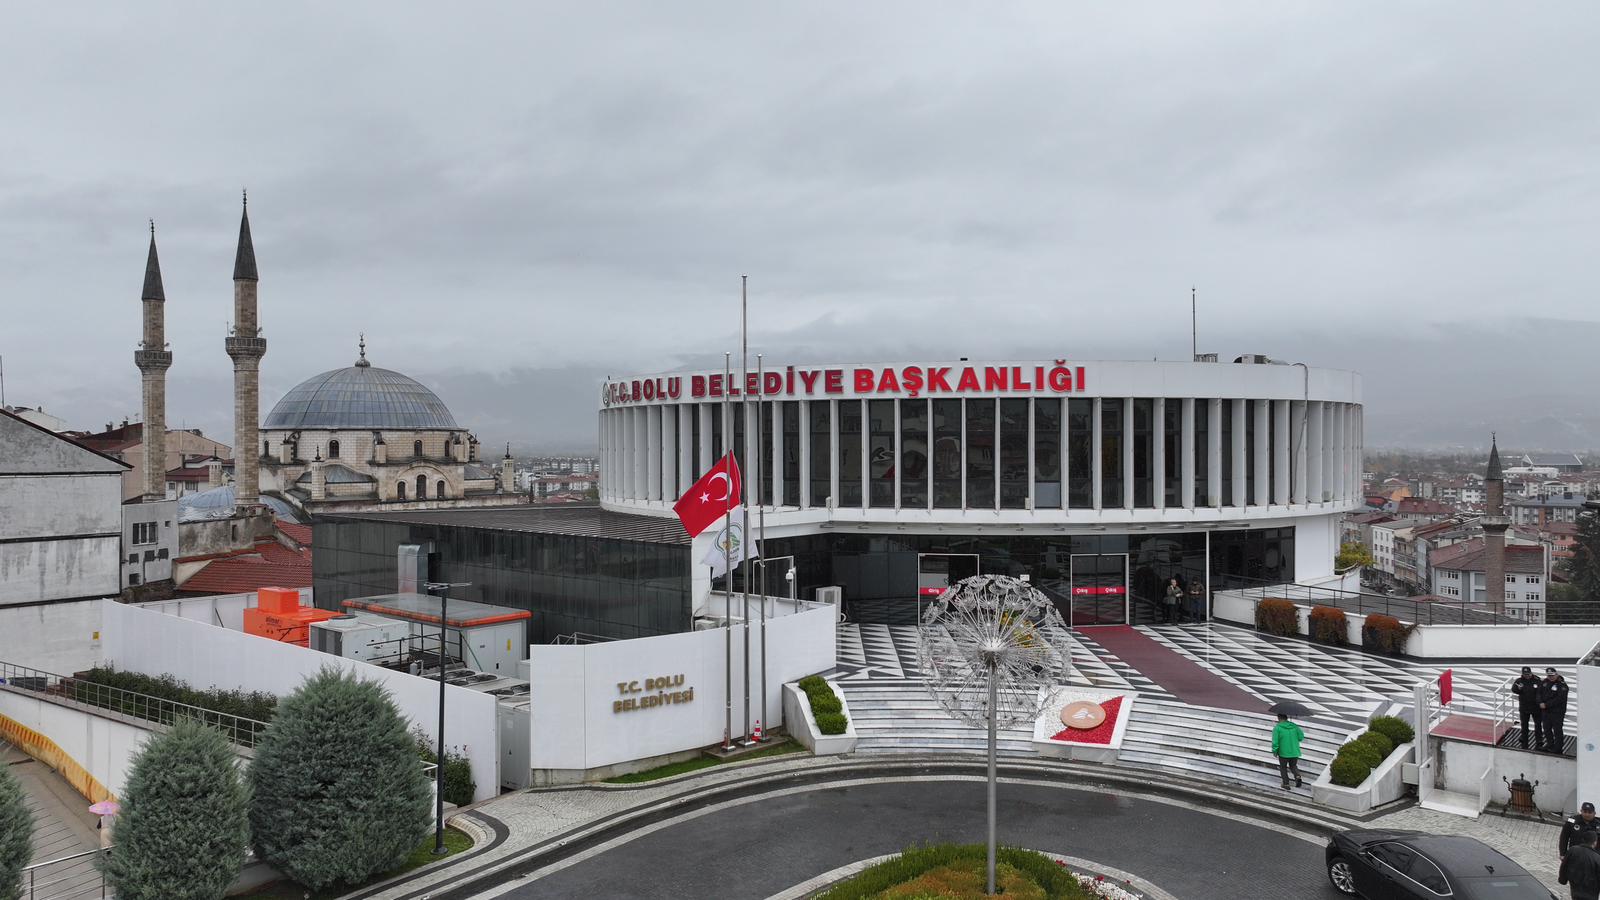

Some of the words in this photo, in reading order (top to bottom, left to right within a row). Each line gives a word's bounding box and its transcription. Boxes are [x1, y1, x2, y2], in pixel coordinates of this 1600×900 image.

[691, 365, 844, 398] BELEDİYE
[853, 359, 1086, 398] BAŞKANLIĞI
[617, 681, 642, 695] T.C.
[645, 674, 685, 691] BOLU
[613, 686, 694, 713] BELEDİYESİ
